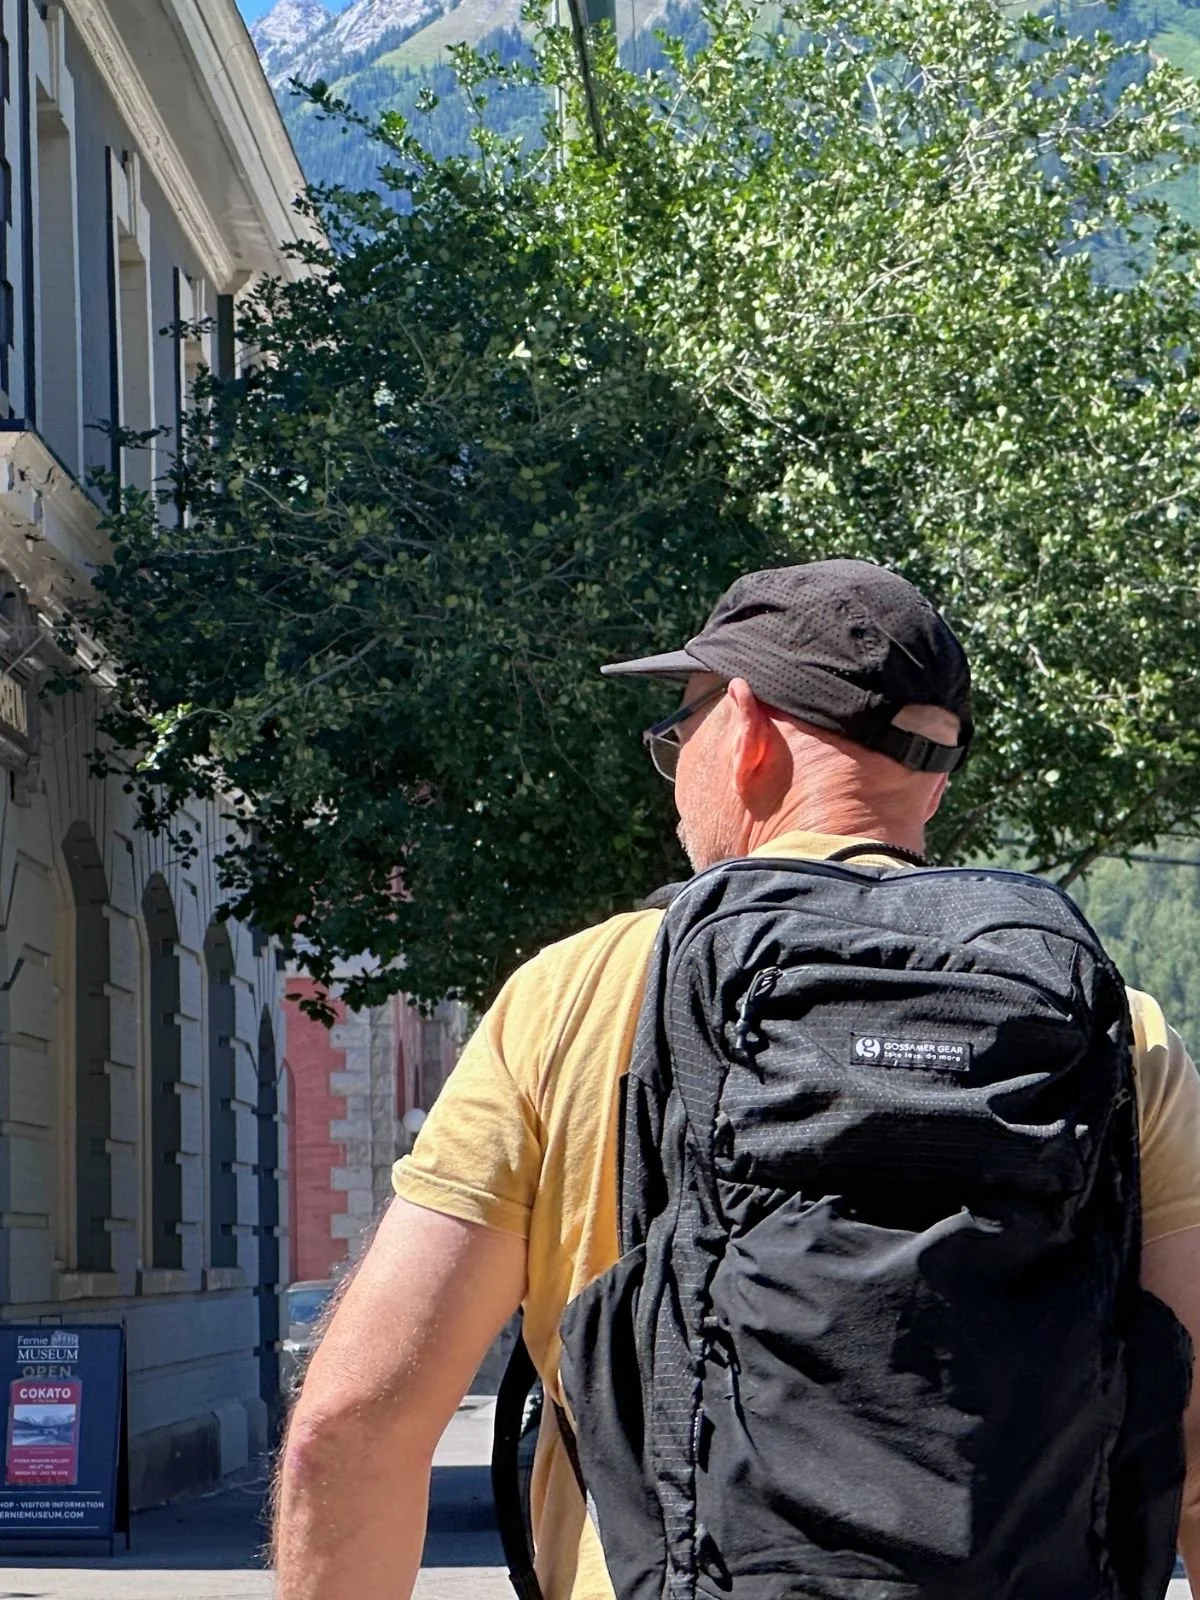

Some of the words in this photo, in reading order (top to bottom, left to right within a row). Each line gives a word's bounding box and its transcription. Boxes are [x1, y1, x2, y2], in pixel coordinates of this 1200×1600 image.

[883, 1042, 936, 1052] GOSSAMER
[937, 1045, 963, 1055] GEAR
[938, 1054, 961, 1062] more
[17, 1335, 48, 1345] Fernie
[18, 1349, 78, 1360] MUSEUM
[22, 1365, 72, 1377] OPEN
[19, 1388, 72, 1399] COKATO
